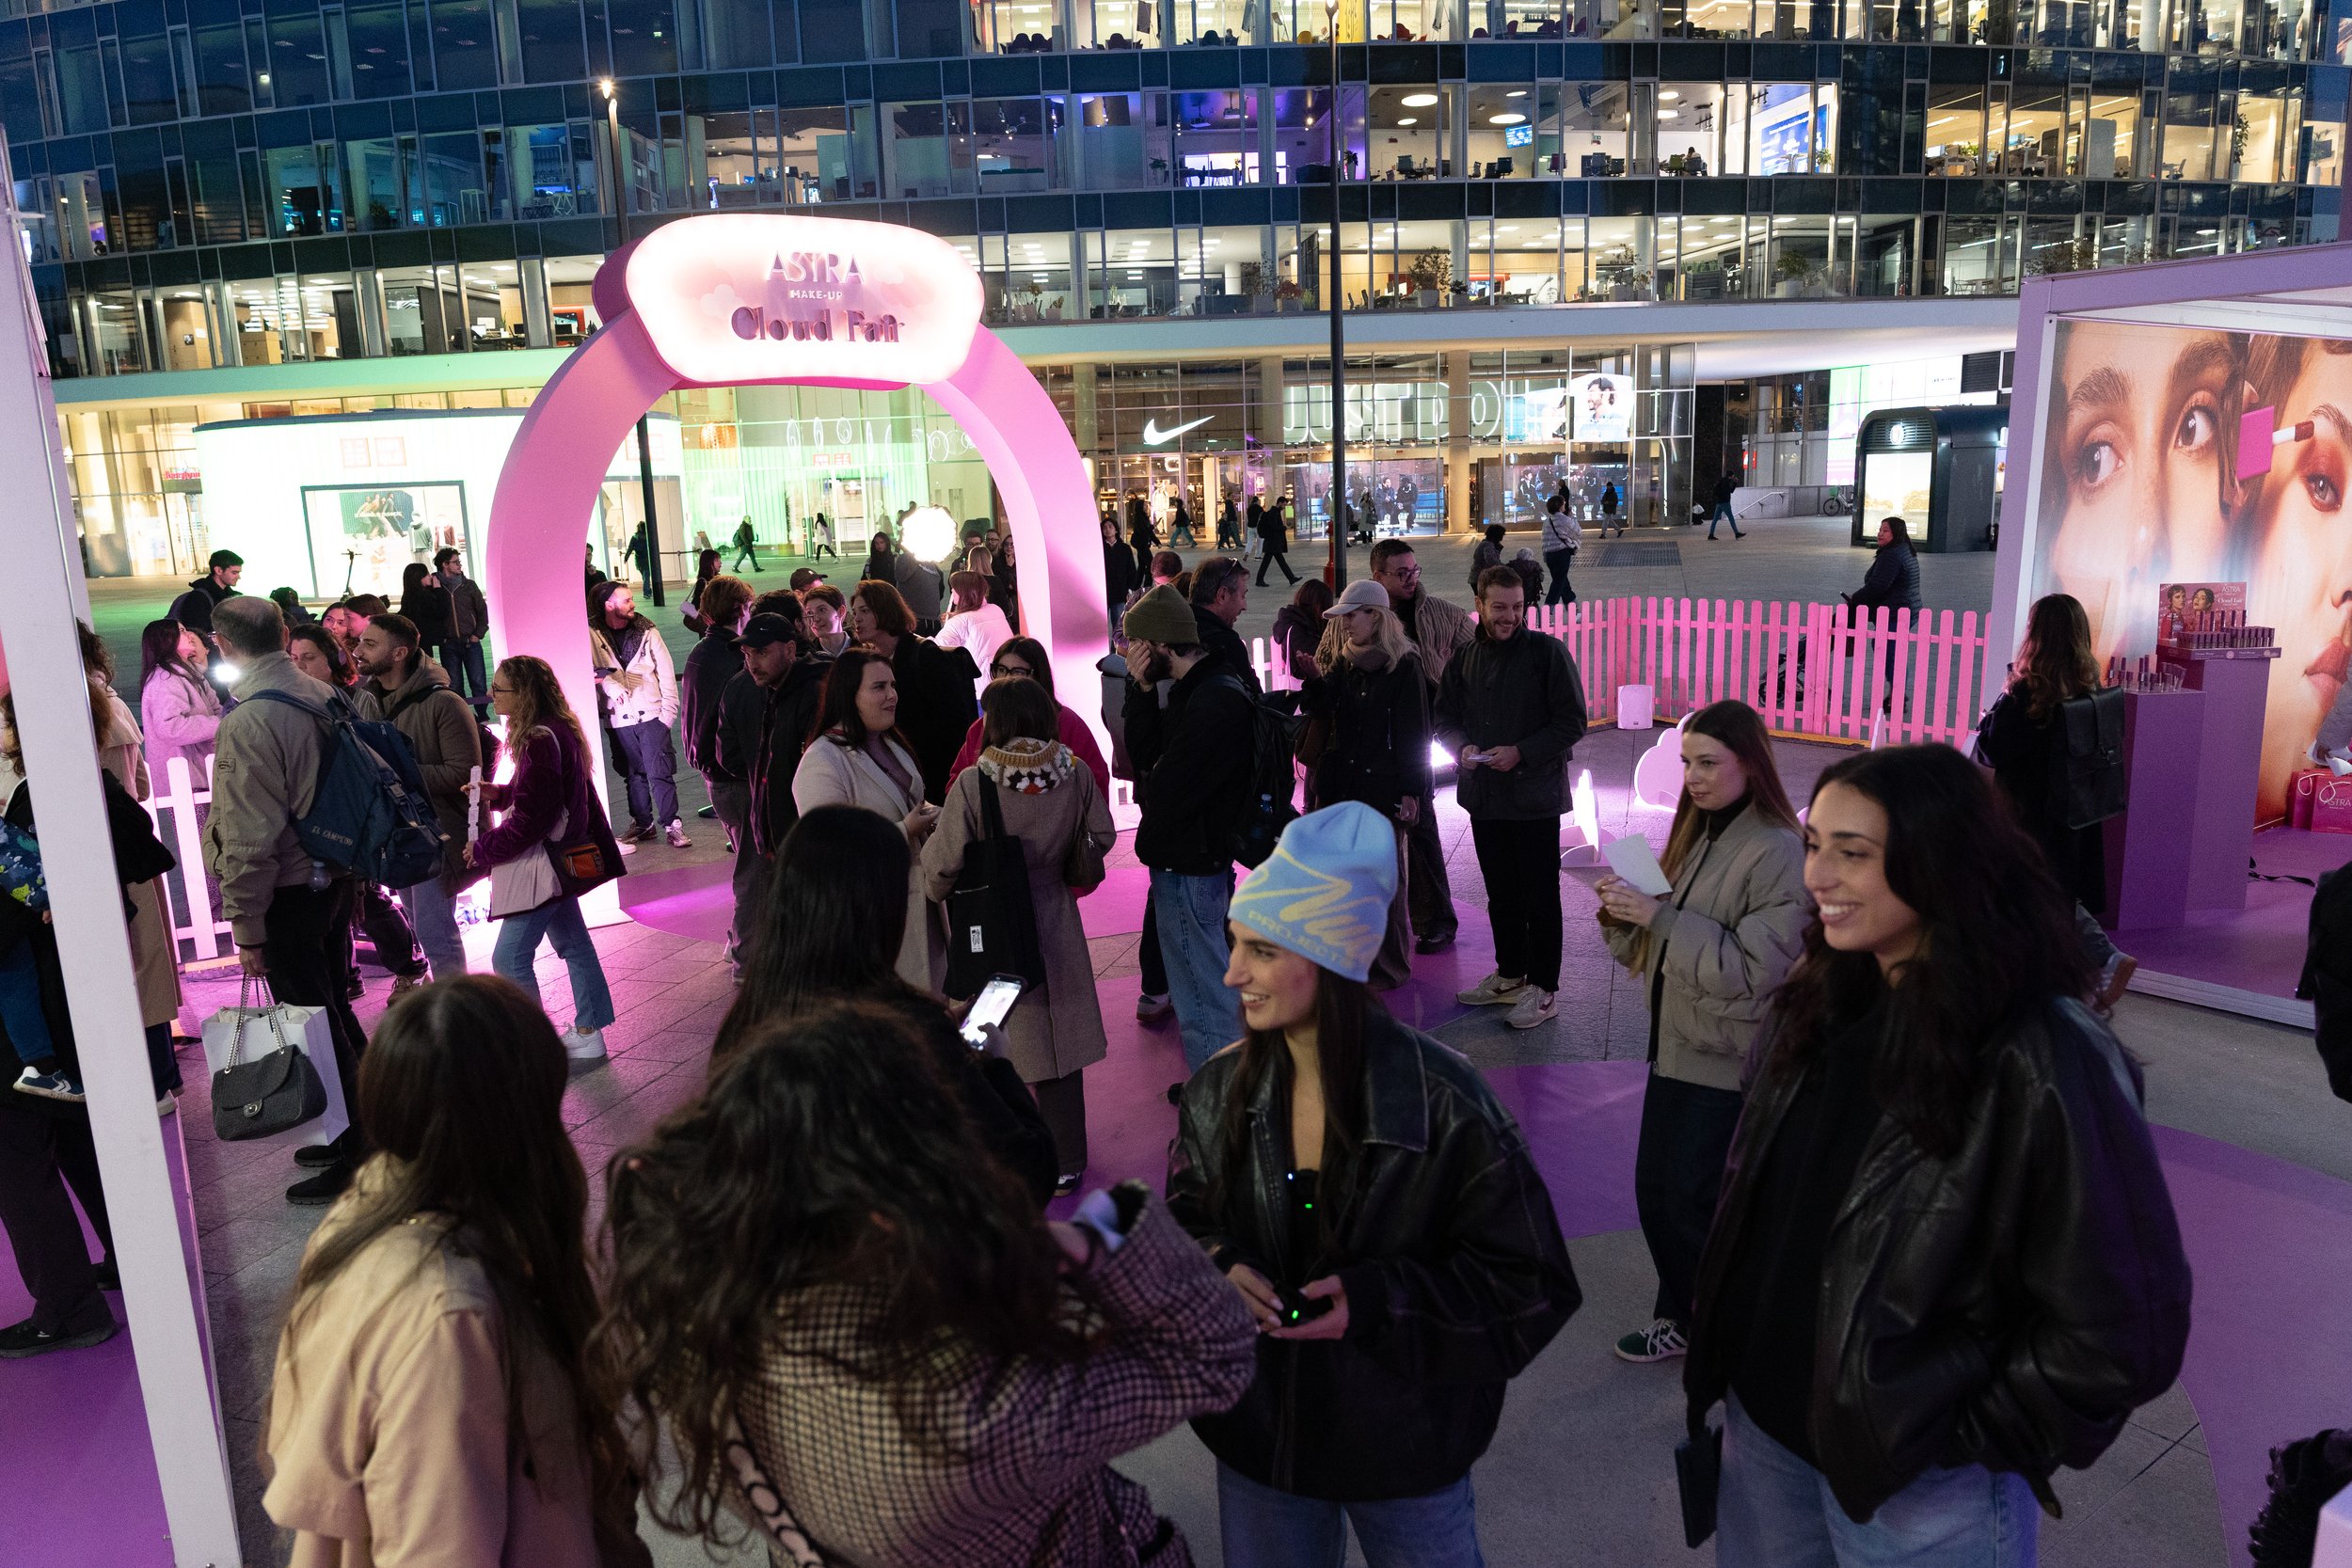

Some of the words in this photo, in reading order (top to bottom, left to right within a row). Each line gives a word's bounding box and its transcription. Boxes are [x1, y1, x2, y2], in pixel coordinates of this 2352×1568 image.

[767, 250, 865, 284] ASTRA
[790, 290, 843, 300] MAKE-UP
[731, 306, 834, 341] Cloud
